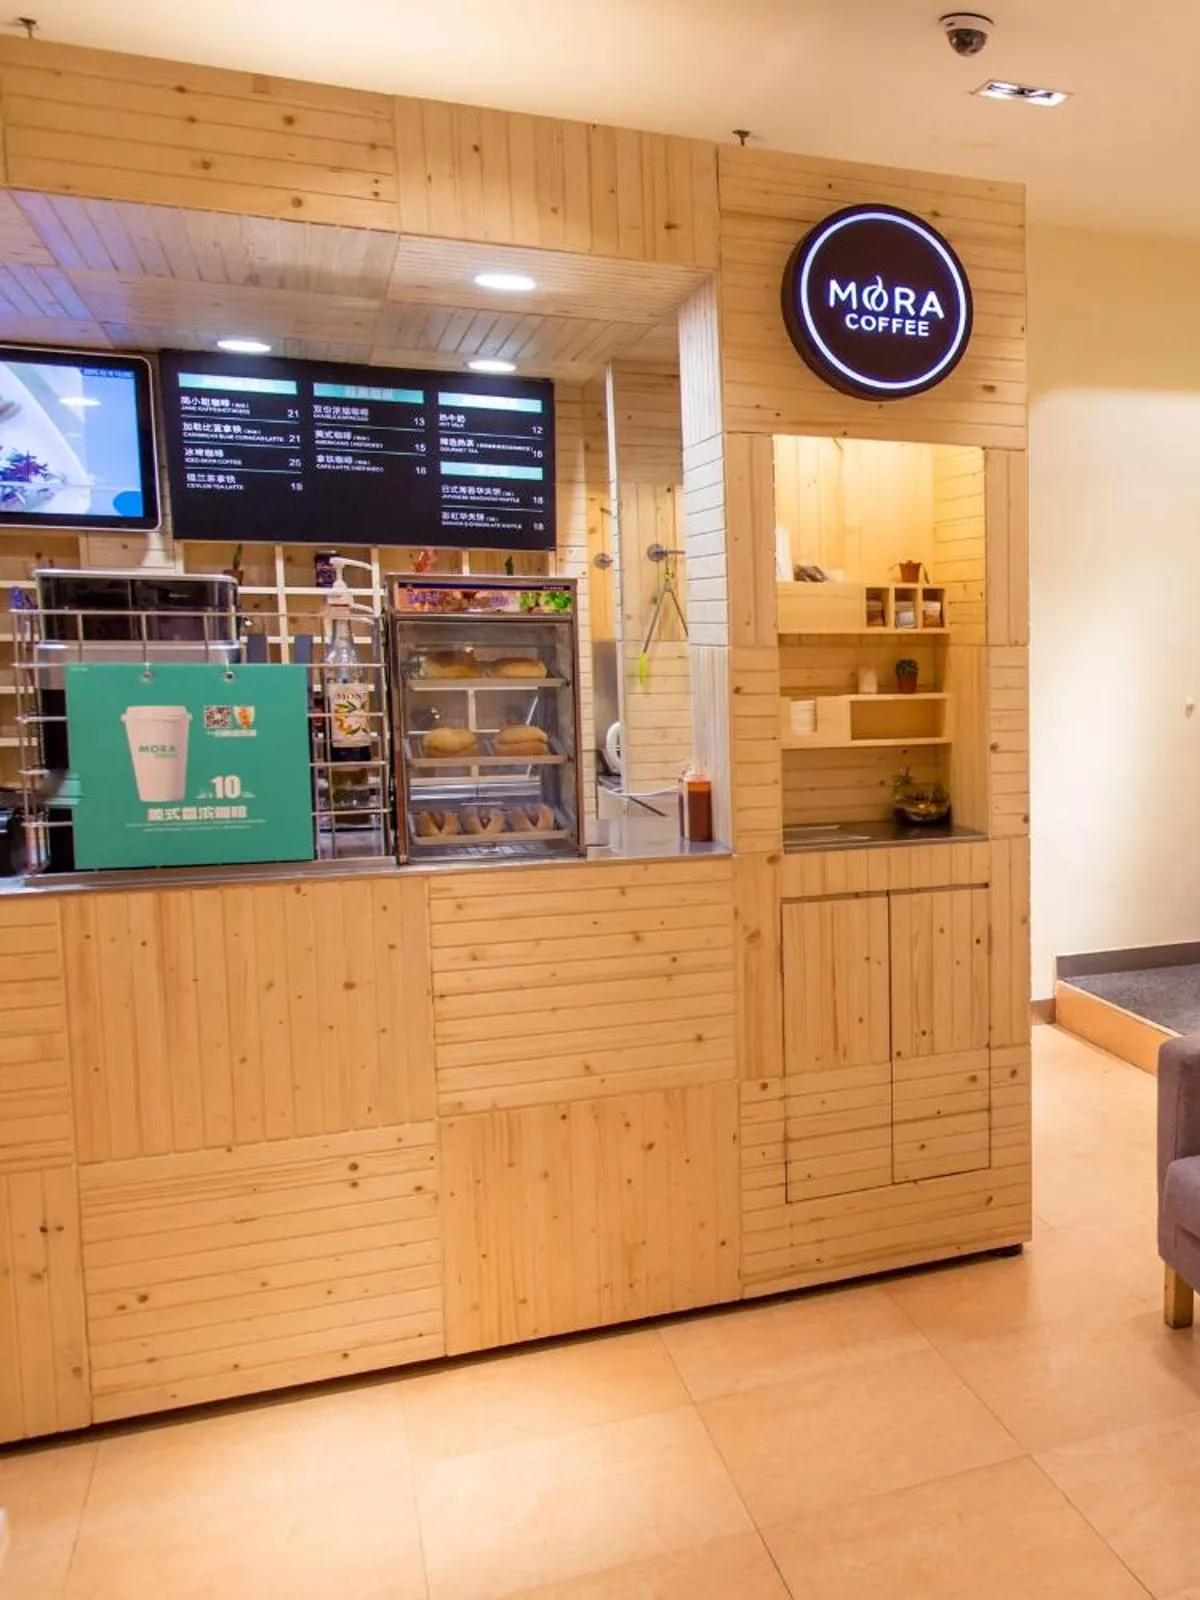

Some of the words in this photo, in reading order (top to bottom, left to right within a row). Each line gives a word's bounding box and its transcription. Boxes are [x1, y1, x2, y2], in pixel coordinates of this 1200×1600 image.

[829, 276, 945, 319] MORA
[845, 313, 930, 336] COFFEE
[287, 409, 299, 418] 21
[532, 426, 543, 434] 12
[288, 434, 300, 443] 21
[211, 775, 241, 799] 10
